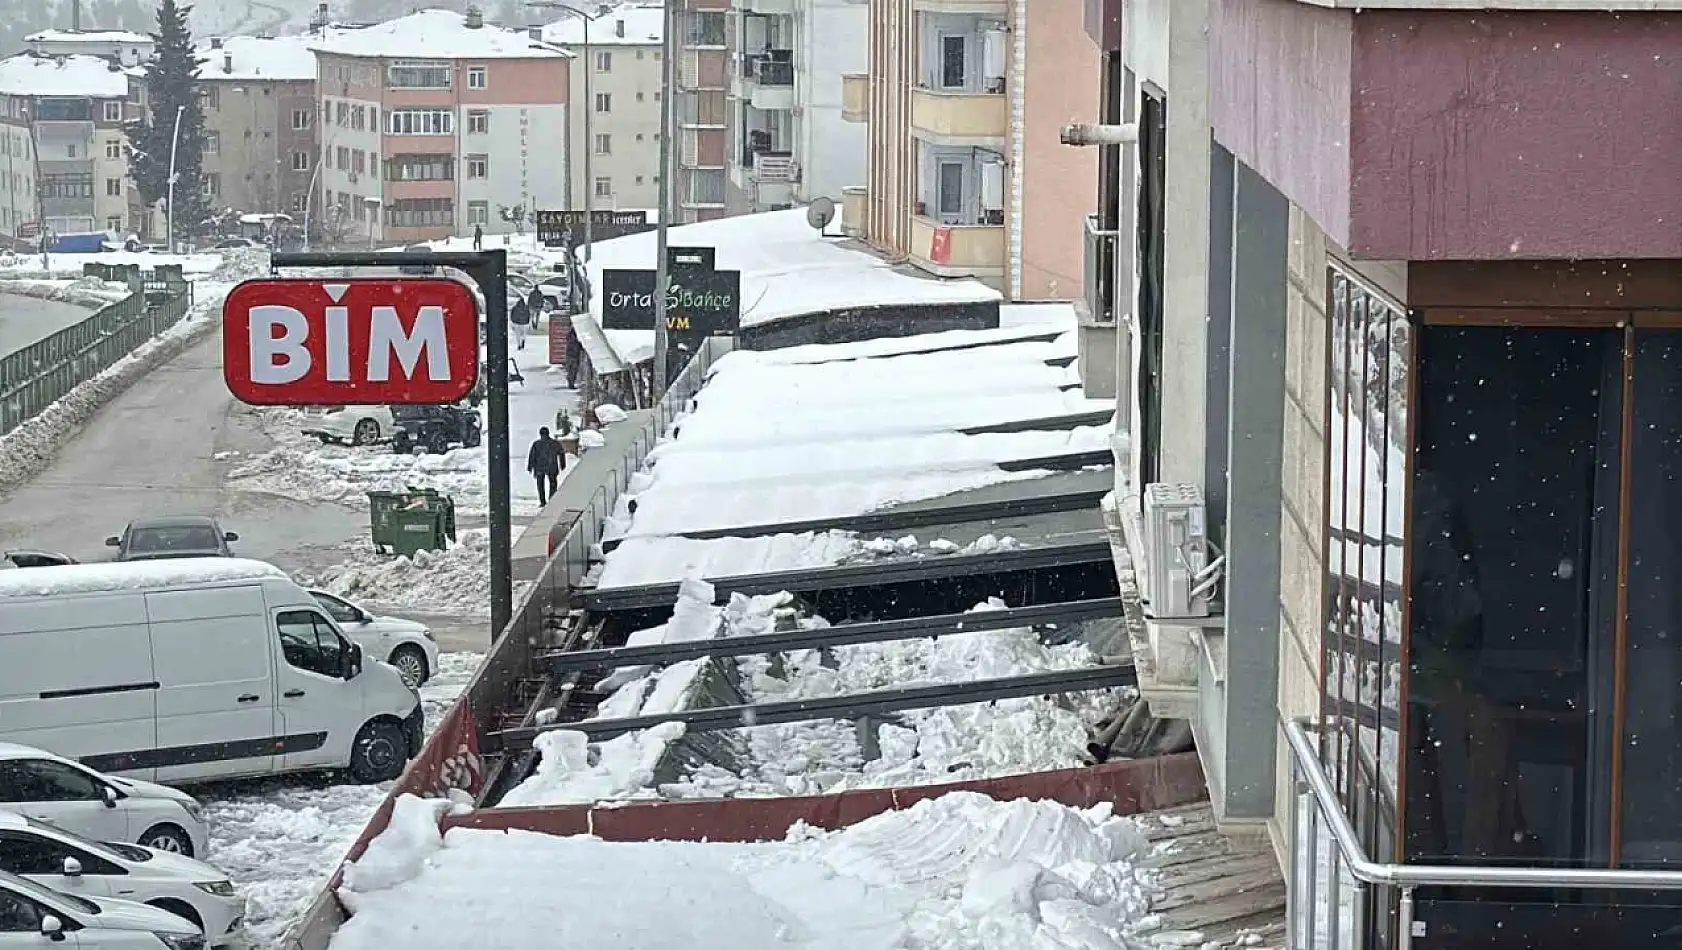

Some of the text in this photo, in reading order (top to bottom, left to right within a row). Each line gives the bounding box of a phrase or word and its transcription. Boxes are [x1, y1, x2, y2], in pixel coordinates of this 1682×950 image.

[609, 289, 731, 311] Orta Bahçe
[248, 284, 452, 385] BİM
[665, 317, 690, 330] VM
